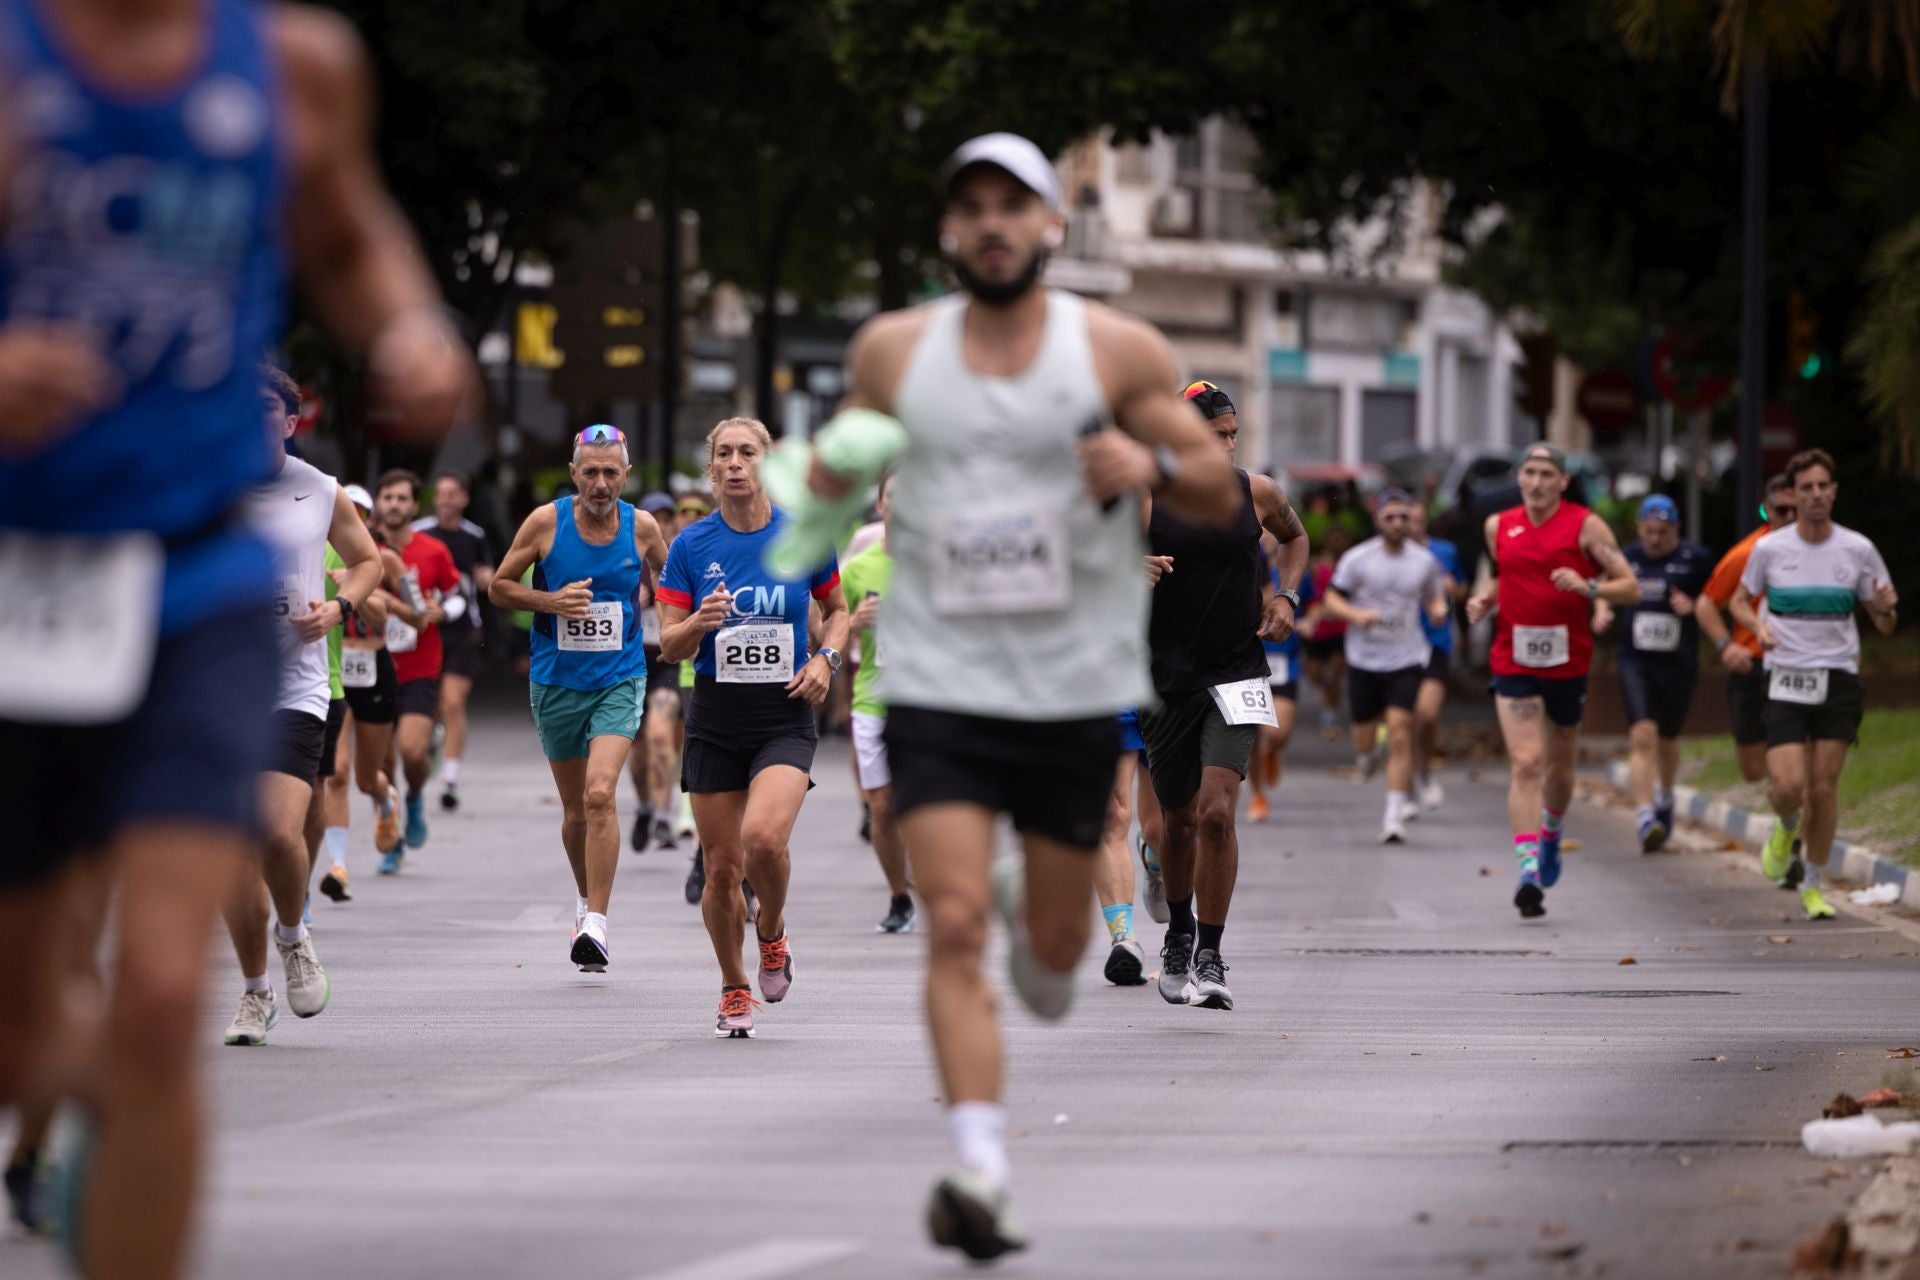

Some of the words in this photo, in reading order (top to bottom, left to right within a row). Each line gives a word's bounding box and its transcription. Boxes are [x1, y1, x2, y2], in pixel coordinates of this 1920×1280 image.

[567, 620, 612, 636] 583
[726, 645, 780, 664] 268
[1528, 642, 1552, 656] 90
[1241, 690, 1266, 708] 63
